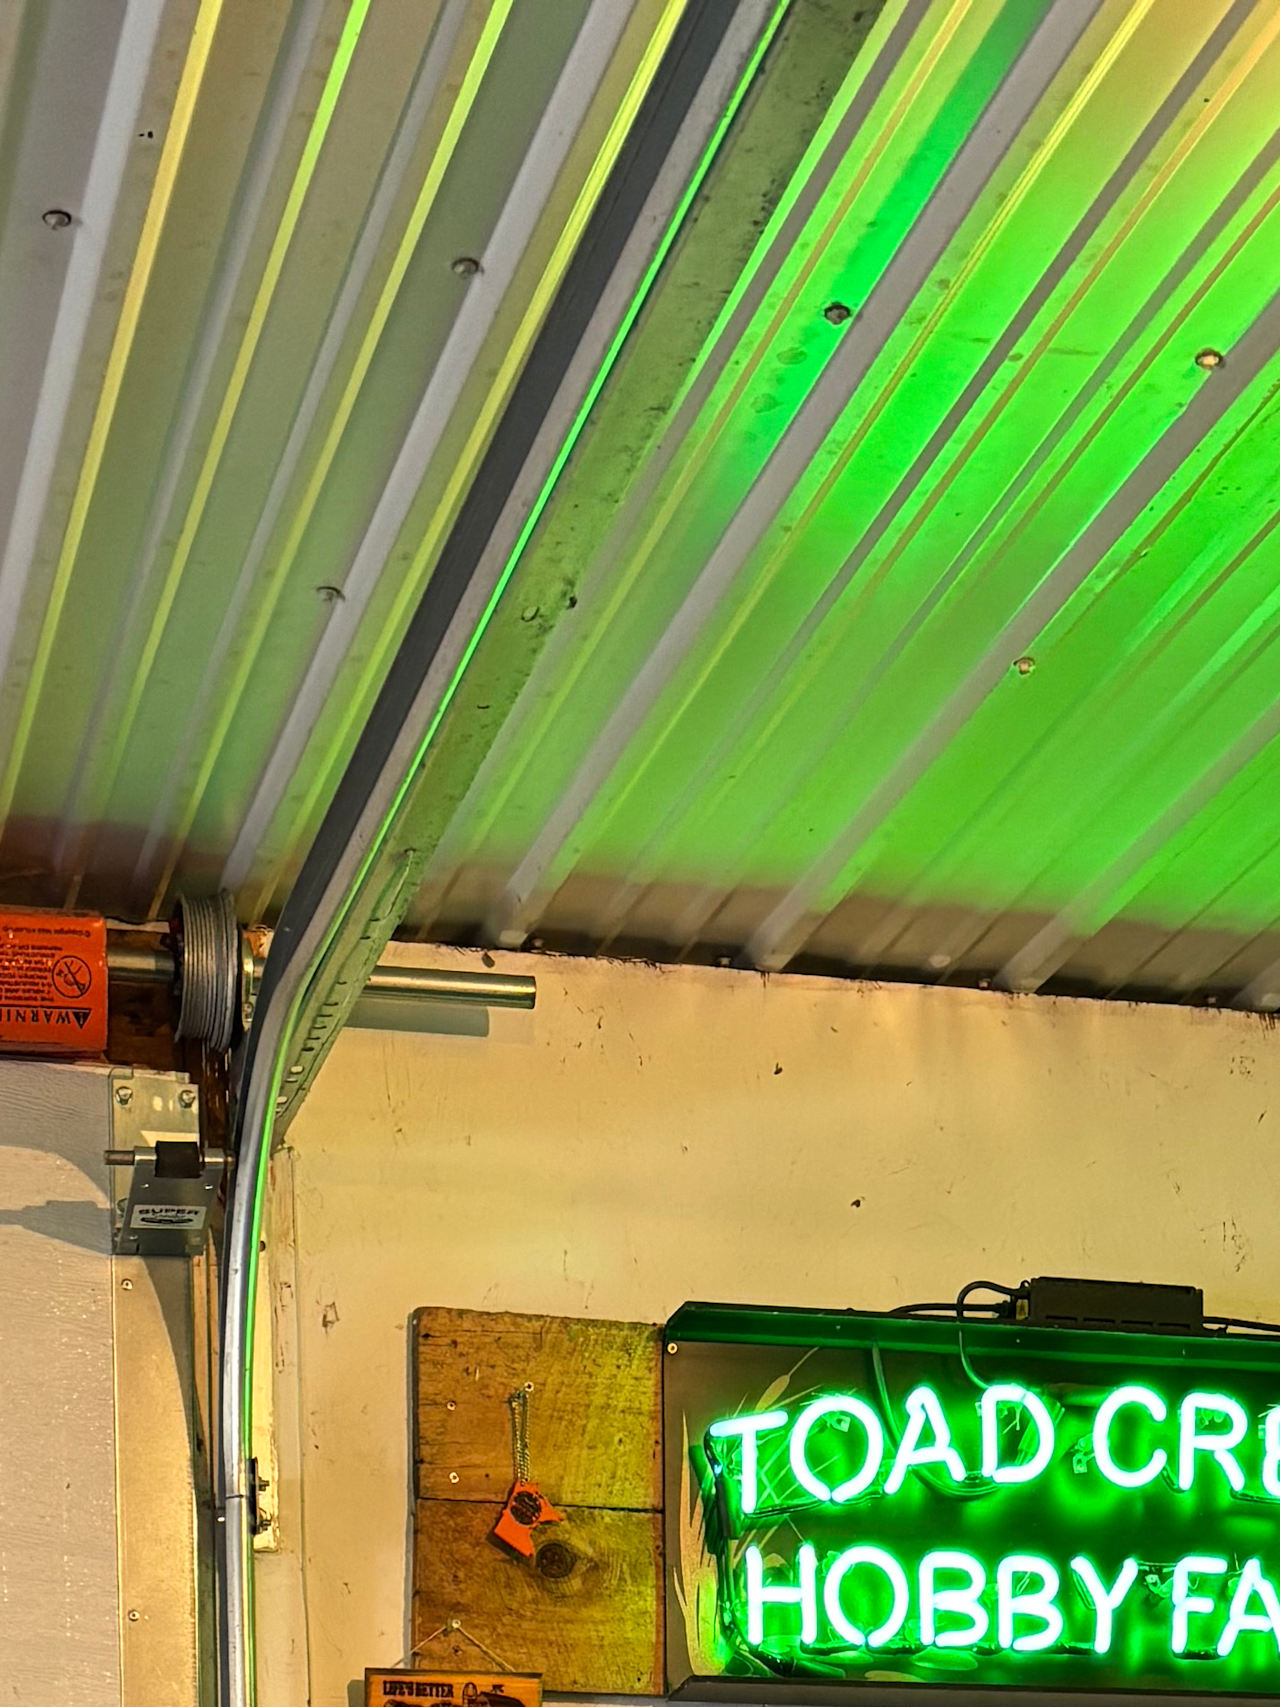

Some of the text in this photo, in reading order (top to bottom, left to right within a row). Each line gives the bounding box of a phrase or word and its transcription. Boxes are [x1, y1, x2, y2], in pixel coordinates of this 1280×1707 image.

[709, 1384, 1055, 1514] TOAD
[745, 1543, 1138, 1654] HOBBY
[415, 1683, 454, 1698] BETTER
